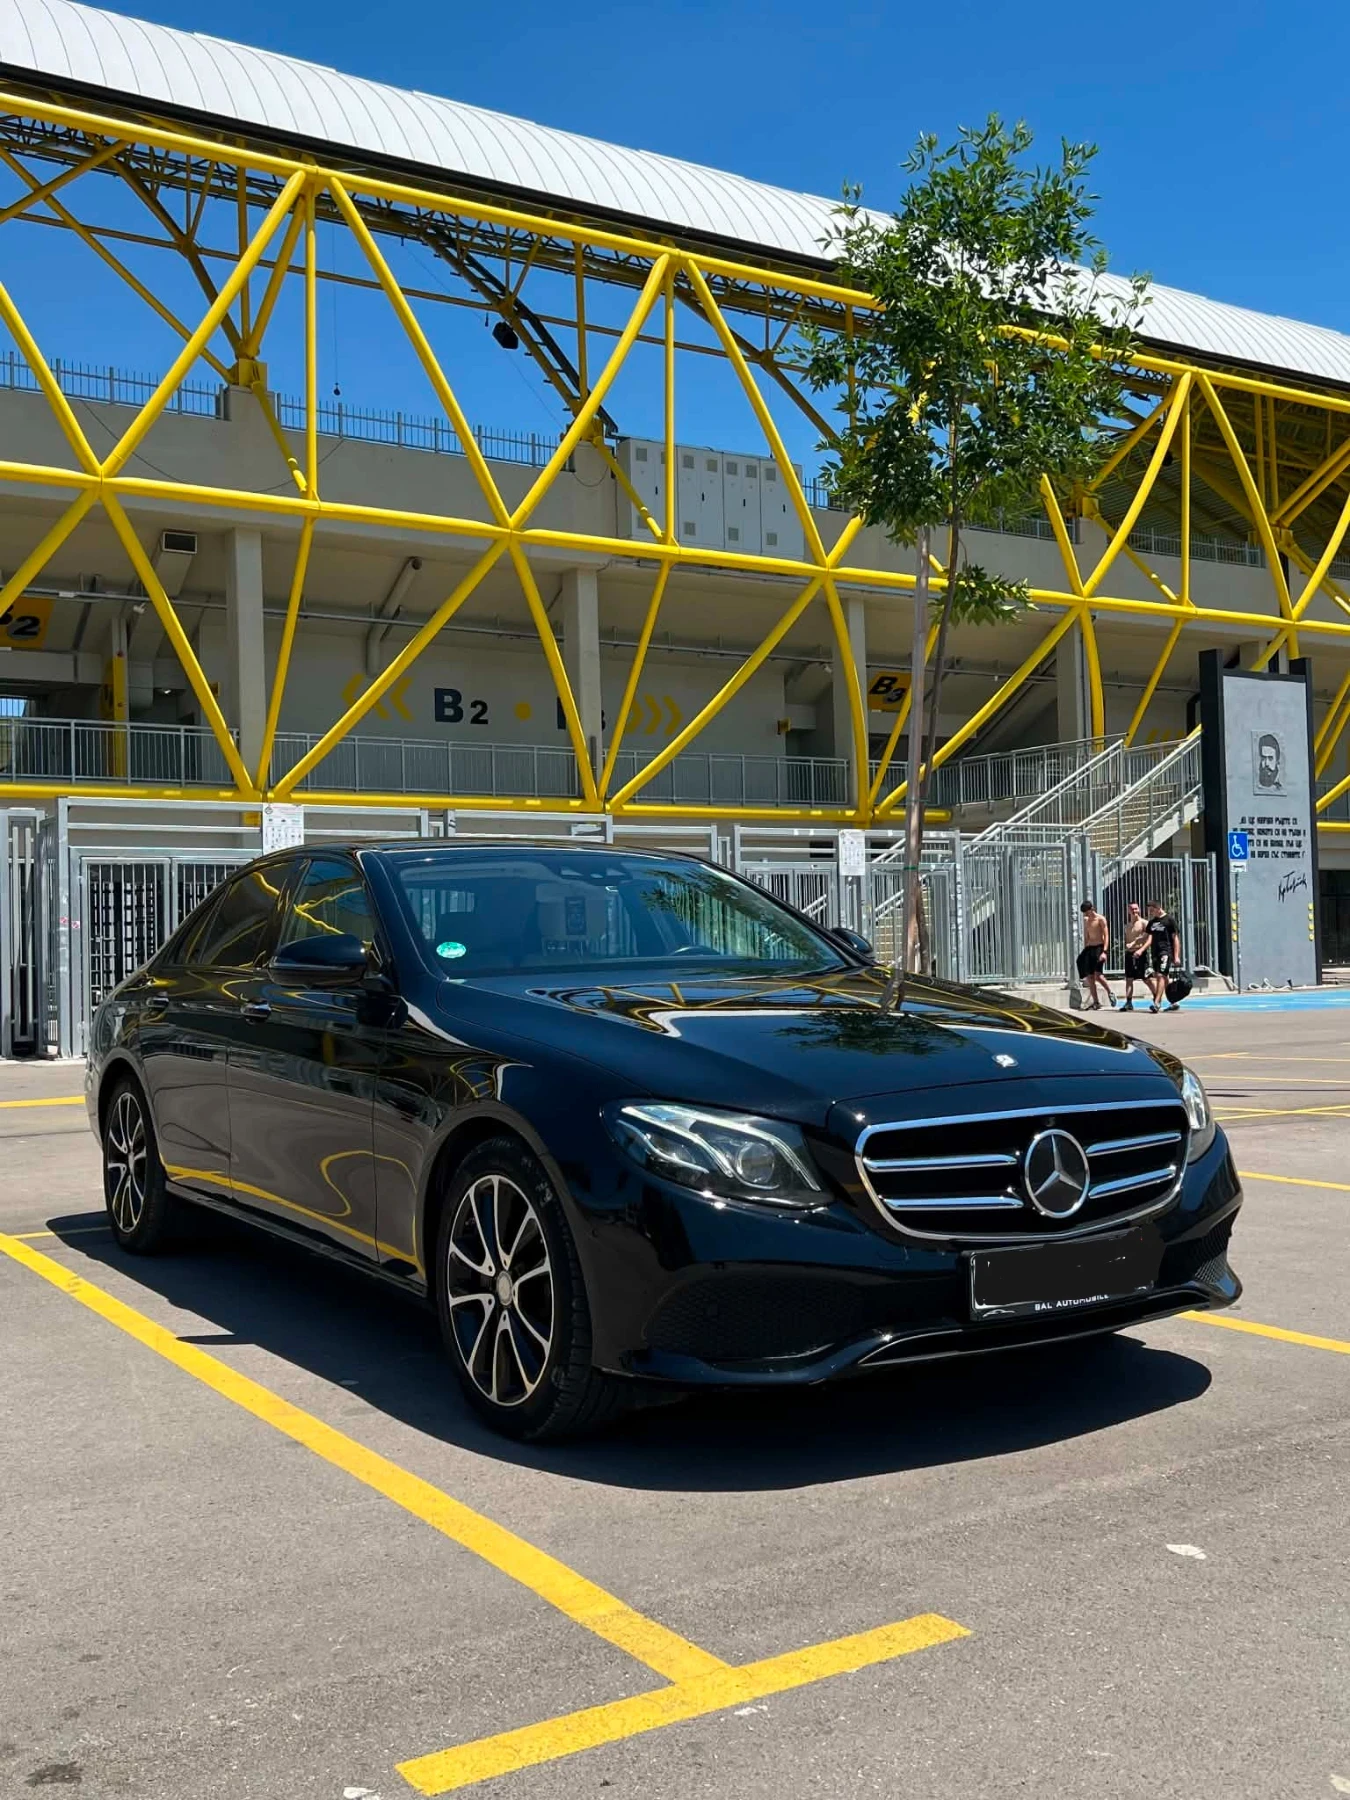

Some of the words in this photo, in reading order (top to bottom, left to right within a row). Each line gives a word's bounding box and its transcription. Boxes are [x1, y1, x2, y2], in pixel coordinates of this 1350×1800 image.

[869, 676, 907, 704] B3
[434, 687, 489, 725] B2
[1035, 1302, 1053, 1311] BAL
